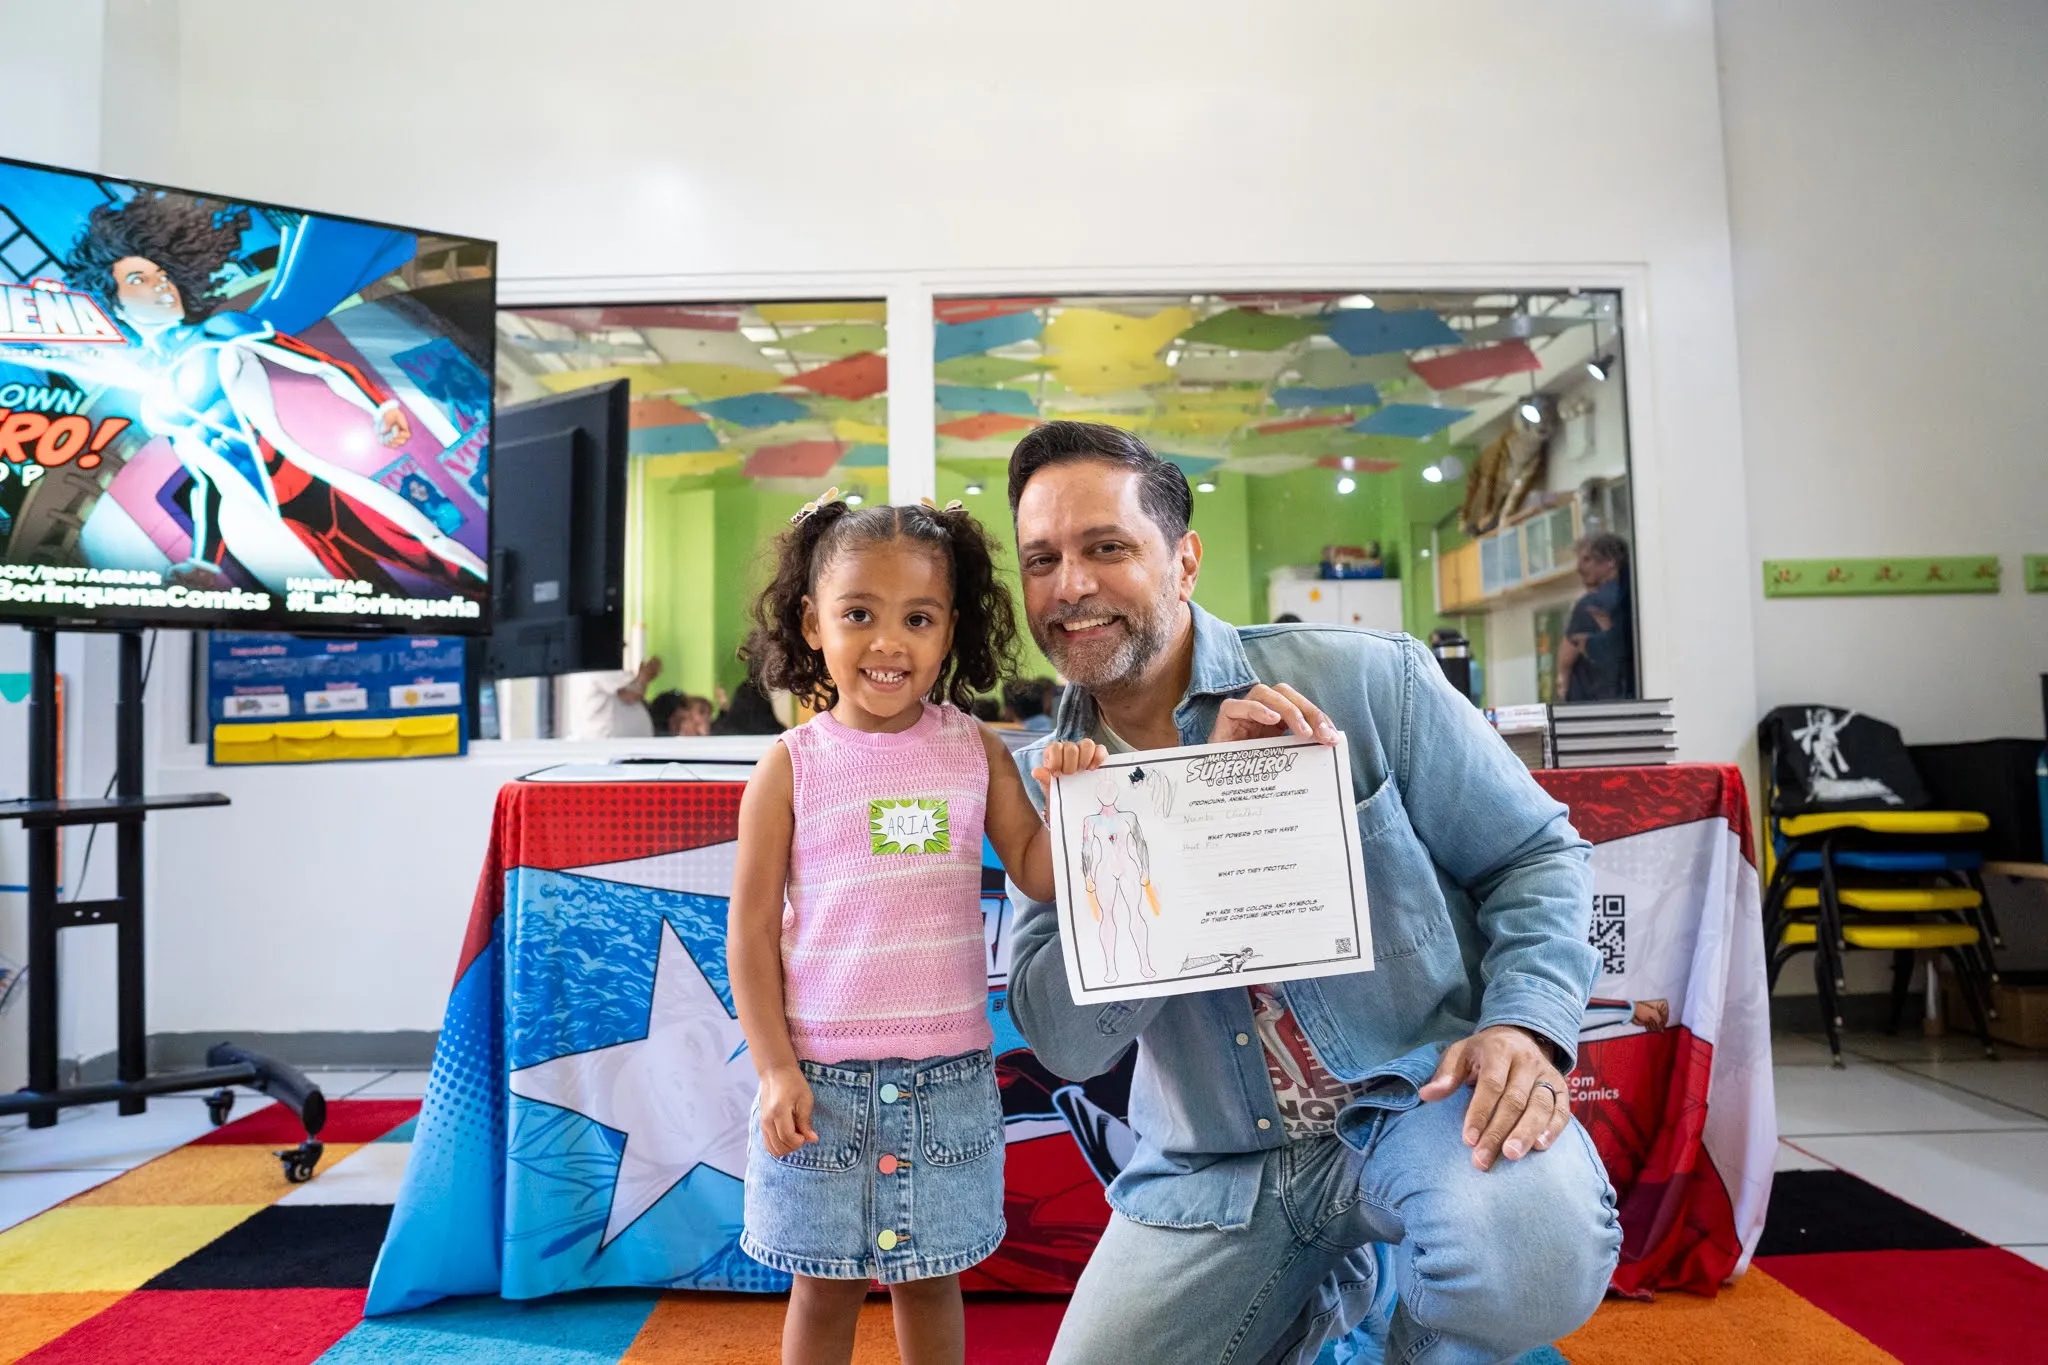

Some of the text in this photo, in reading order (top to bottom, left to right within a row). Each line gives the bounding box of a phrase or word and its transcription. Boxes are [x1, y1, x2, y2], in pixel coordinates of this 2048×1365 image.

[0, 382, 83, 415] OWN
[0, 408, 133, 470] RO!
[286, 577, 374, 595] HASHTAG:
[286, 591, 481, 620] #LaBorinqueña
[1204, 747, 1285, 763] MAKE YOUR OWN
[1187, 752, 1298, 783] SUPERHERO!
[1206, 772, 1278, 787] WORKSHOP
[1221, 787, 1258, 796] SUPERHERO
[887, 815, 930, 836] ARIA
[1225, 831, 1251, 839] POWERS
[1279, 825, 1299, 833] HAVE?
[1263, 863, 1297, 872] PROTECT?
[1212, 915, 1228, 923] THEIR
[1230, 912, 1259, 921] COSTUME
[1261, 908, 1295, 917] IMPORTANT
[1308, 904, 1325, 912] YOU?
[1246, 904, 1273, 912] COLORS
[1289, 899, 1317, 907] SYMBOLS
